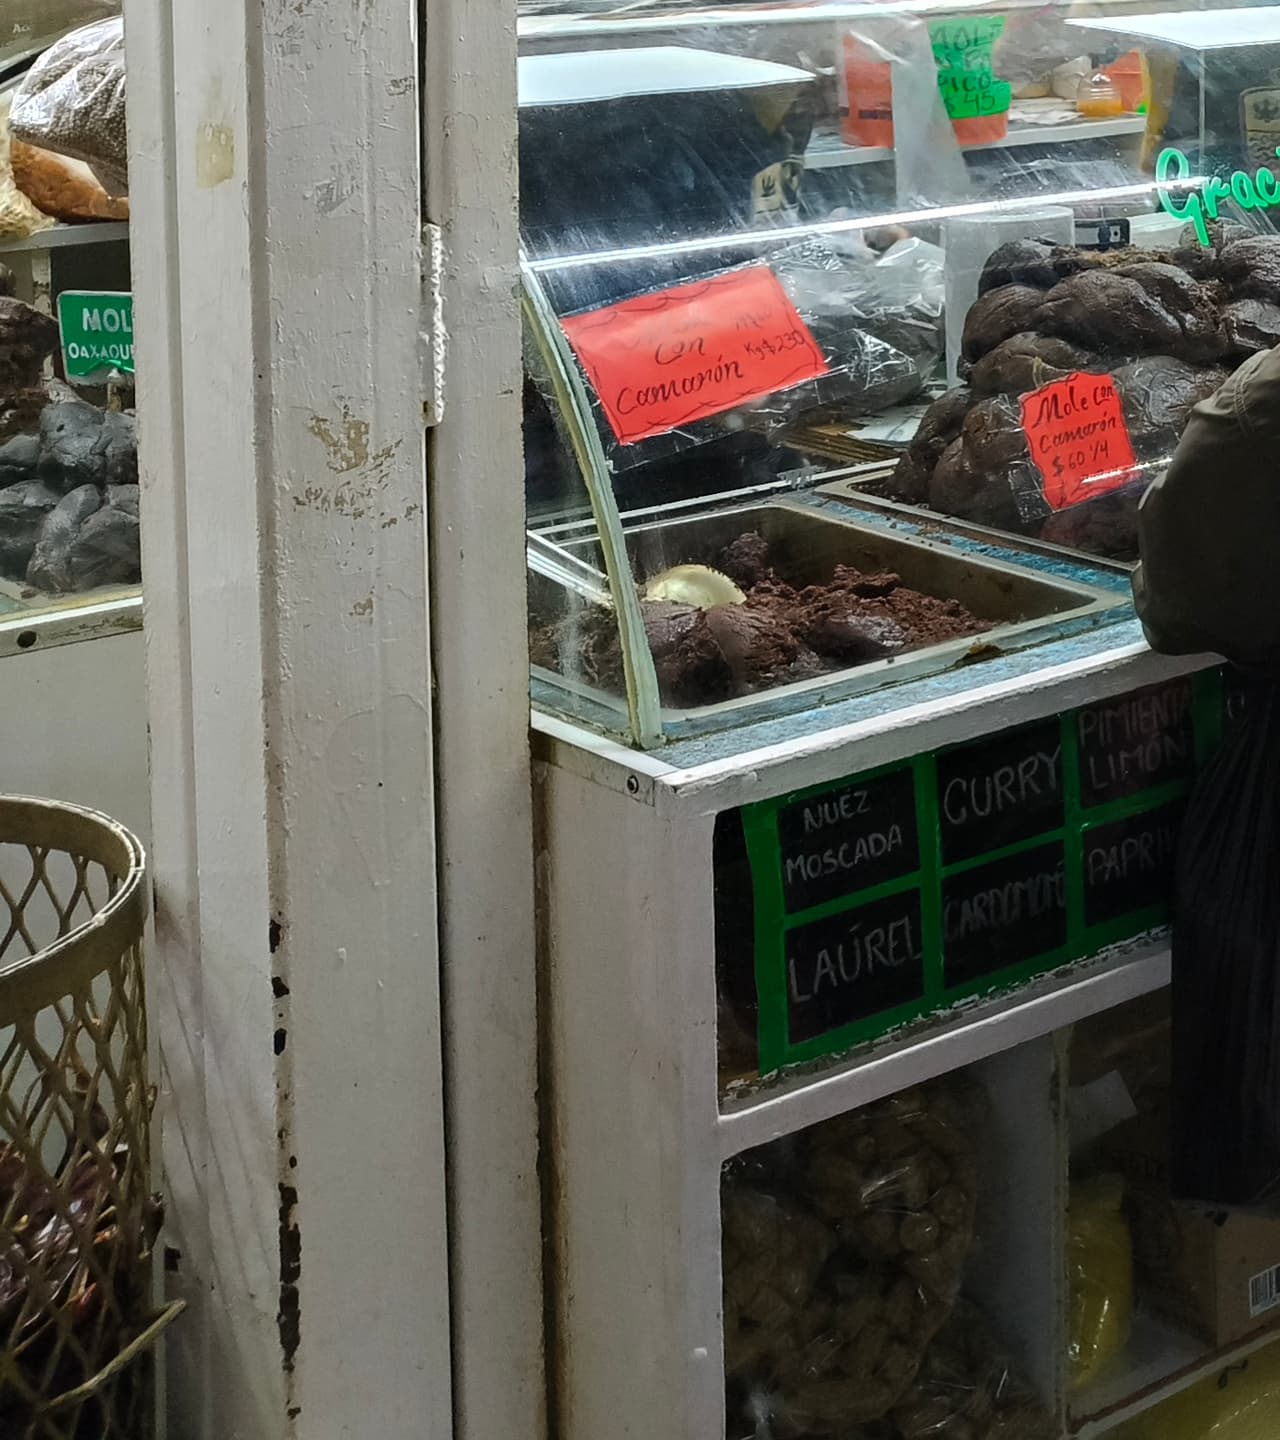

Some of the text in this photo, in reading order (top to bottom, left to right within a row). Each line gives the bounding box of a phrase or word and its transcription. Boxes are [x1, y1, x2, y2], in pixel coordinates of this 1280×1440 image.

[82, 307, 133, 332] MOL
[616, 356, 744, 415] Camarón
[1031, 385, 1089, 430] Mole
[1039, 410, 1117, 454] Camarón
[941, 744, 1062, 827] CURRY
[785, 823, 903, 885] MOSCADA
